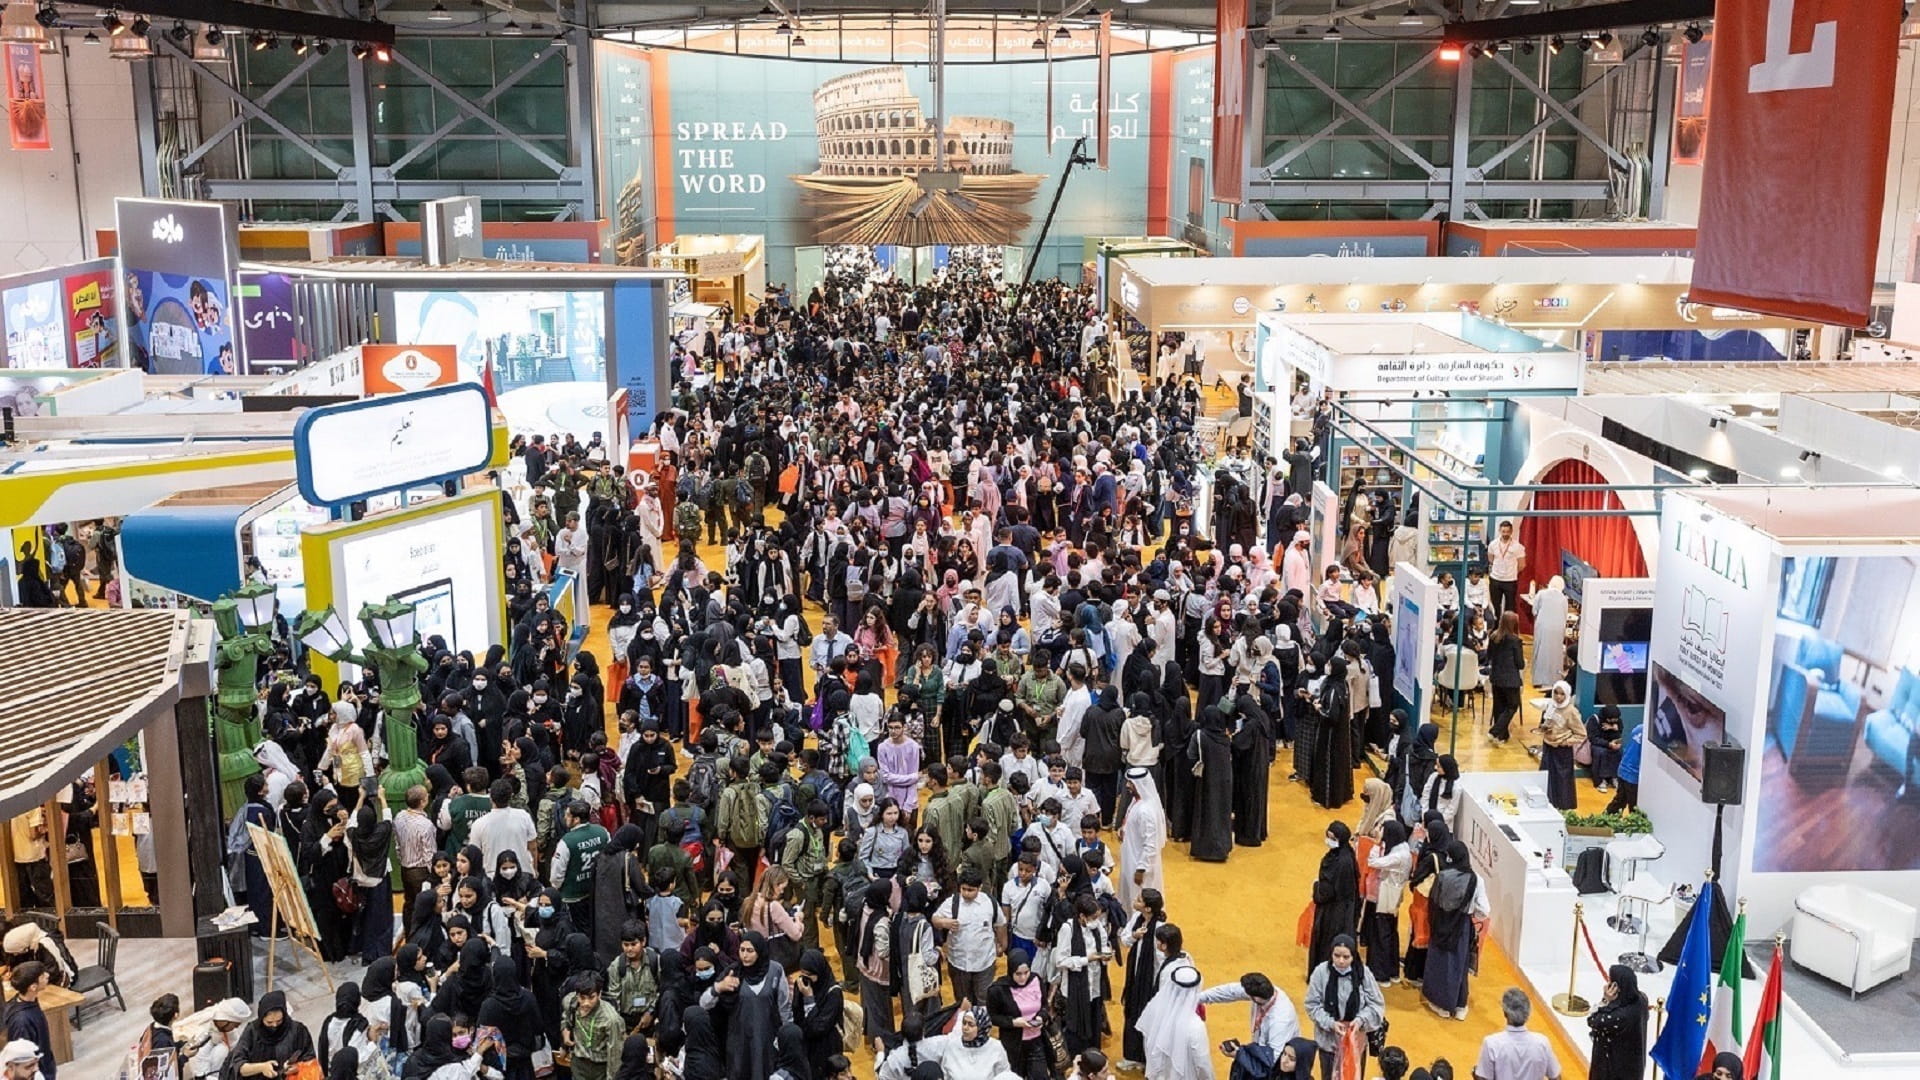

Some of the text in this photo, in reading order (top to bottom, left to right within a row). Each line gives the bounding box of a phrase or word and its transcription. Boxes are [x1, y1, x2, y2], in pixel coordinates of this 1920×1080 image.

[677, 121, 788, 141] SPREAD
[678, 149, 735, 169] THE
[679, 174, 766, 194] WORD
[1377, 374, 1416, 383] Department
[1675, 520, 1748, 590] ITALIA
[464, 809, 488, 819] SENIO
[580, 850, 600, 871] 2
